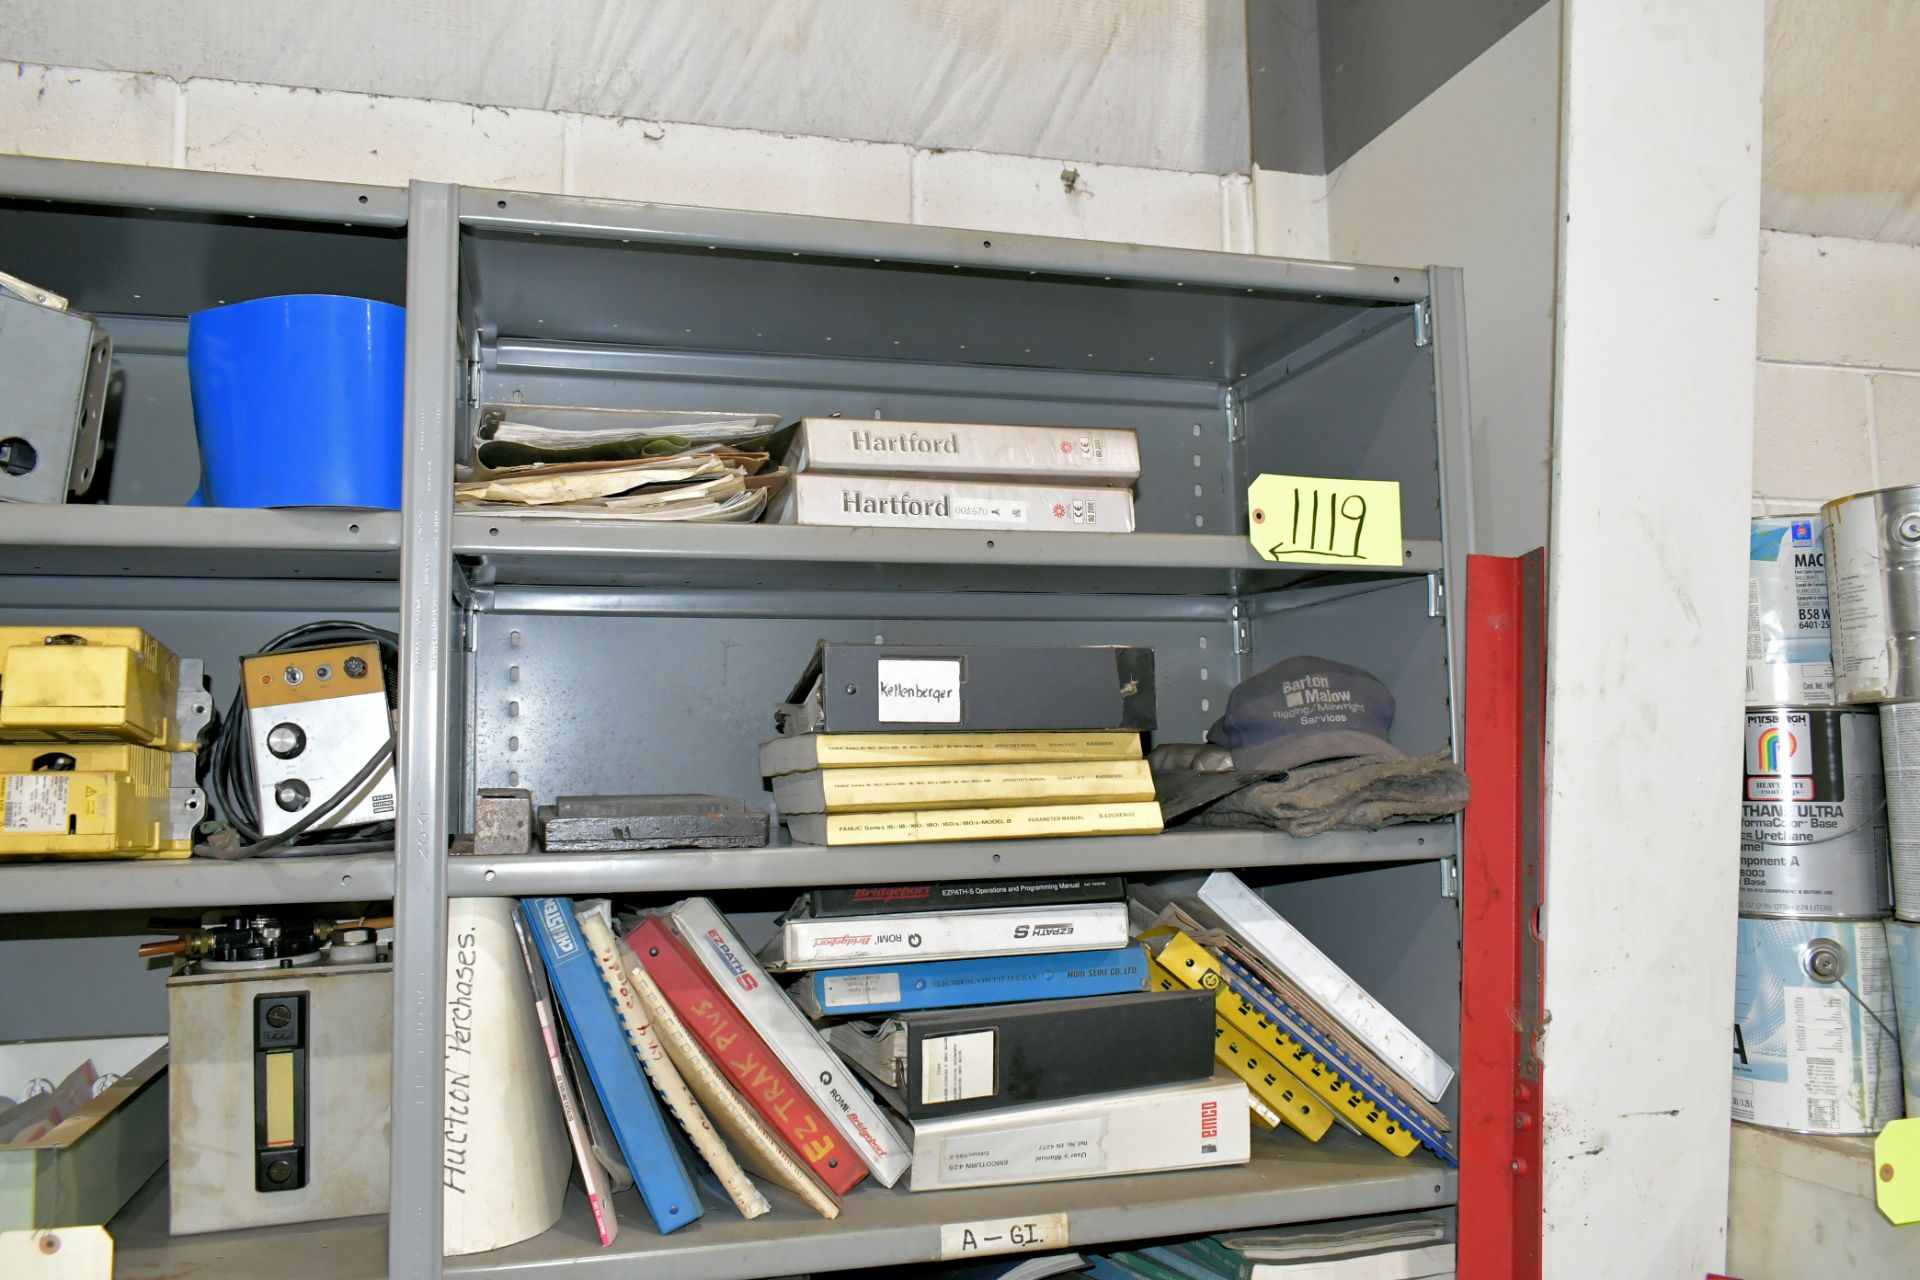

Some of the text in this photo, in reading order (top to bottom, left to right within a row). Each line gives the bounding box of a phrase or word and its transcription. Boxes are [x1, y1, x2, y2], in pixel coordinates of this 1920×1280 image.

[851, 430, 960, 455] Hartford
[841, 489, 950, 517] Hartford
[1292, 488, 1367, 557] 1119
[1798, 608, 1820, 620] B58
[1282, 675, 1330, 694] Barton
[1305, 689, 1351, 703] Malow
[1300, 714, 1347, 725] Services
[1797, 805, 1844, 818] ULTRA
[1810, 818, 1838, 828] Base
[852, 885, 932, 902] Bridgeport
[942, 888, 975, 897] EZPATH-S
[975, 886, 1007, 895] Operations
[1020, 883, 1058, 893] Programming
[731, 1052, 795, 1123] TRAK
[1201, 1101, 1217, 1138] emco
[794, 1114, 834, 1163] EZ
[847, 1110, 887, 1159] Bridgeport
[966, 1159, 1008, 1169] EMCOTURN
[1035, 1154, 1062, 1162] Manual
[1064, 1151, 1087, 1159] User's
[962, 1229, 977, 1251] A
